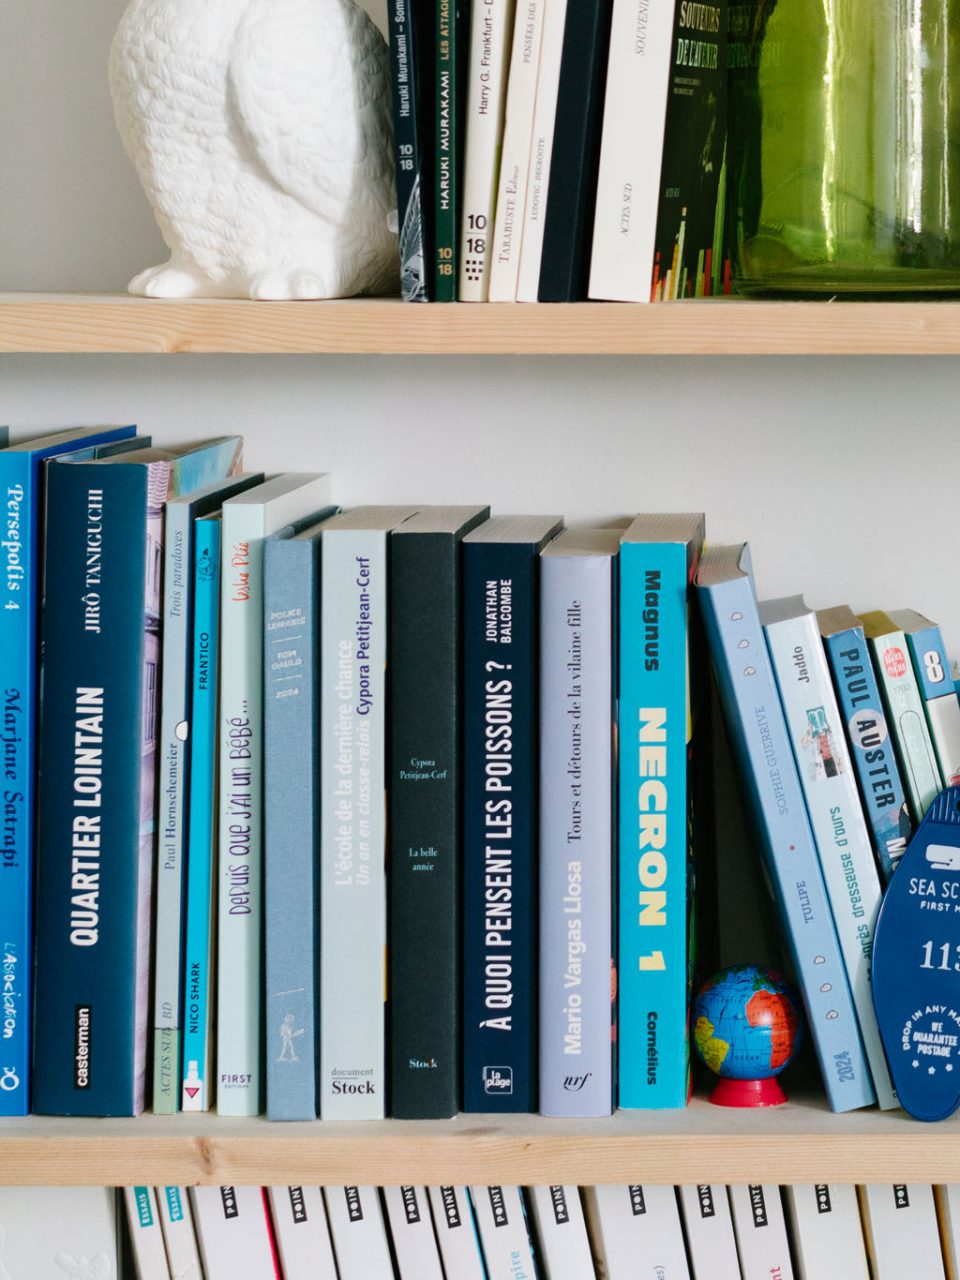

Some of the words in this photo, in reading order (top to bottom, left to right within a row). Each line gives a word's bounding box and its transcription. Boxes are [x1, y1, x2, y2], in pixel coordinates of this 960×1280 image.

[441, 40, 449, 60] LES
[441, 72, 449, 150] MURAKAMI
[441, 157, 449, 209] HARUKI
[5, 485, 24, 590] Persepolis
[86, 490, 102, 587] TANIGUCHI
[5, 600, 19, 609] 4
[82, 593, 100, 633] JIRÔ
[356, 557, 372, 659] Petitjean-Cerf
[486, 581, 497, 642] JONATHAN
[500, 580, 511, 643] BALCOMBE
[567, 601, 581, 626] fille
[642, 571, 660, 671] Magnus
[199, 633, 208, 689] FRANTICO
[567, 632, 581, 679] vilaine
[793, 647, 809, 683] Jaddo
[923, 651, 943, 683] 8
[357, 665, 373, 715] Cypora
[567, 686, 581, 697] la
[568, 702, 580, 719] de
[74, 687, 104, 807] LOINTAIN
[485, 680, 512, 791] POISSONS
[567, 724, 581, 779] détours
[840, 649, 870, 708] PAUL
[857, 720, 896, 808] AUSTER
[571, 785, 581, 796] et
[486, 800, 512, 838] LES
[568, 801, 581, 843] Tours
[639, 708, 667, 925] NECRON
[70, 816, 100, 946] QUARTIER
[485, 846, 512, 945] PENSENT
[563, 861, 582, 913] Llosa
[796, 881, 813, 924] TULIPE
[909, 878, 936, 896] SEA
[921, 901, 950, 911] FIRST
[564, 919, 586, 988] Vargas
[640, 951, 665, 970] 1
[191, 963, 199, 1000] SHARK
[485, 956, 513, 1008] QUOI
[190, 1004, 199, 1033] NICO
[480, 1016, 511, 1030] À
[564, 994, 581, 1054] Mario
[76, 1009, 89, 1086] casterman
[834, 1051, 855, 1082] 2024
[333, 1081, 374, 1094] Stock
